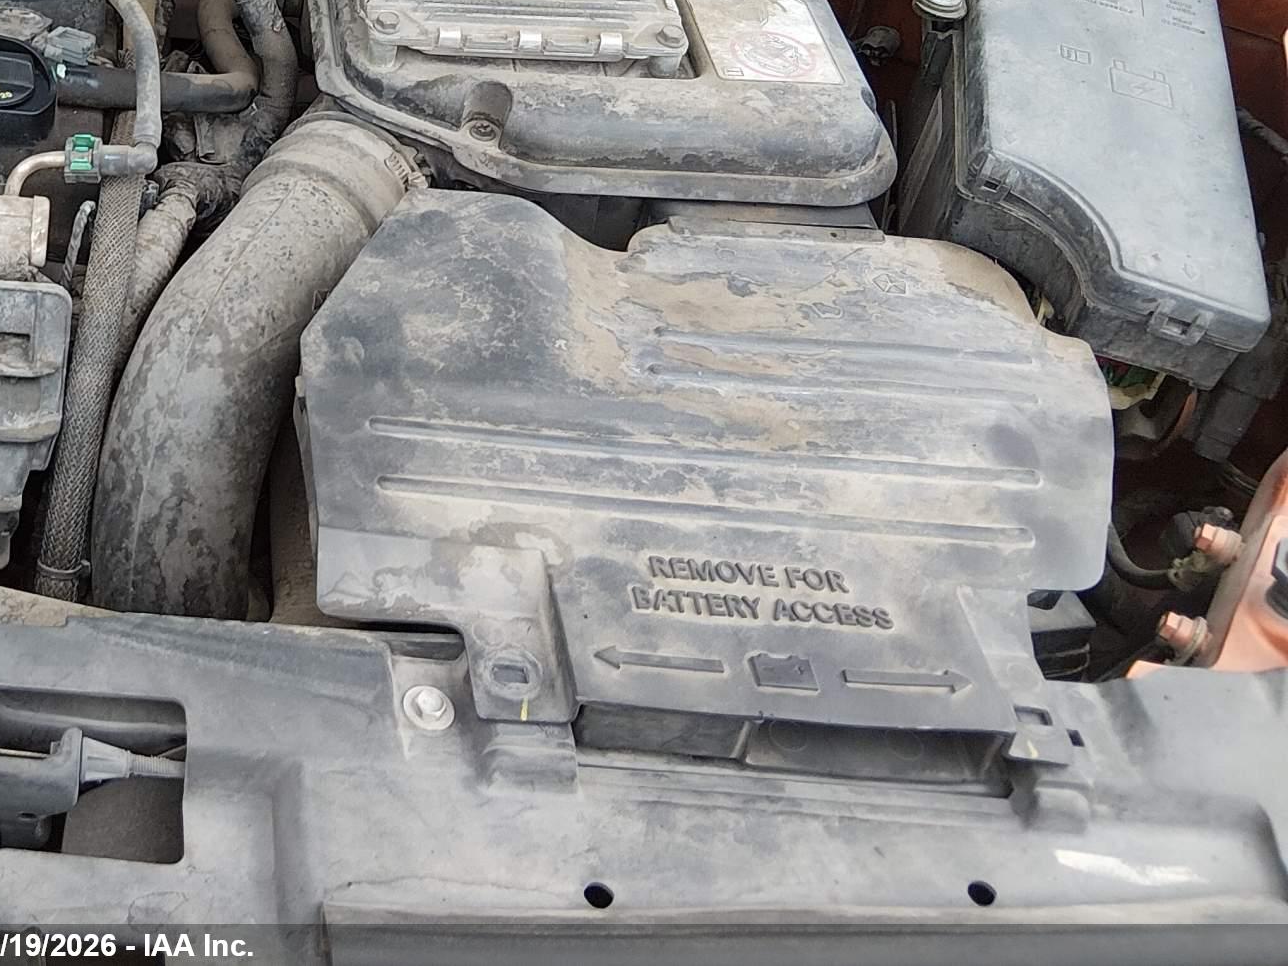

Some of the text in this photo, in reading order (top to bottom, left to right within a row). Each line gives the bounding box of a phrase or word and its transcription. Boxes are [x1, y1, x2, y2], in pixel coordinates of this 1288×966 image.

[648, 555, 850, 594] REMOVE FOR
[631, 586, 894, 630] BATTERY ACCESS
